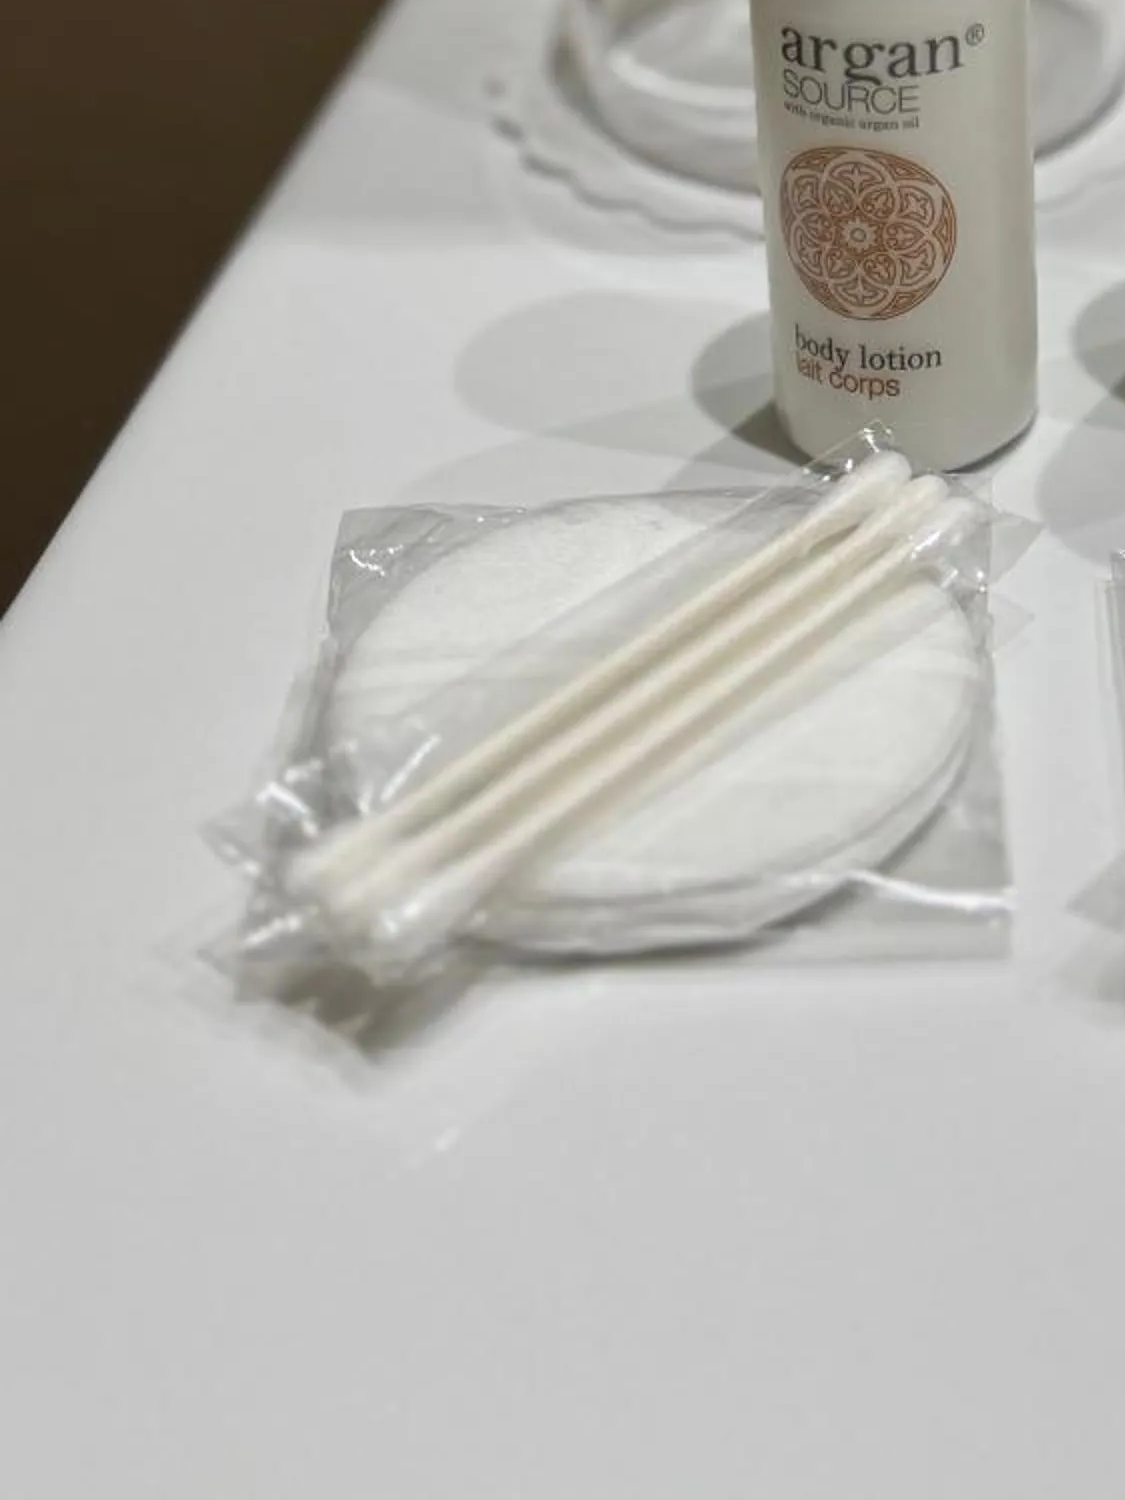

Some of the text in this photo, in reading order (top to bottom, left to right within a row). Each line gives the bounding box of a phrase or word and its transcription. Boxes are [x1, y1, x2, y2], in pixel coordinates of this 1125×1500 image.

[783, 68, 921, 115] SOURCE
[783, 100, 808, 118] with
[809, 109, 856, 130] organic
[857, 116, 899, 132] argan
[794, 323, 943, 372] body lotion
[795, 351, 901, 400] lait corps
